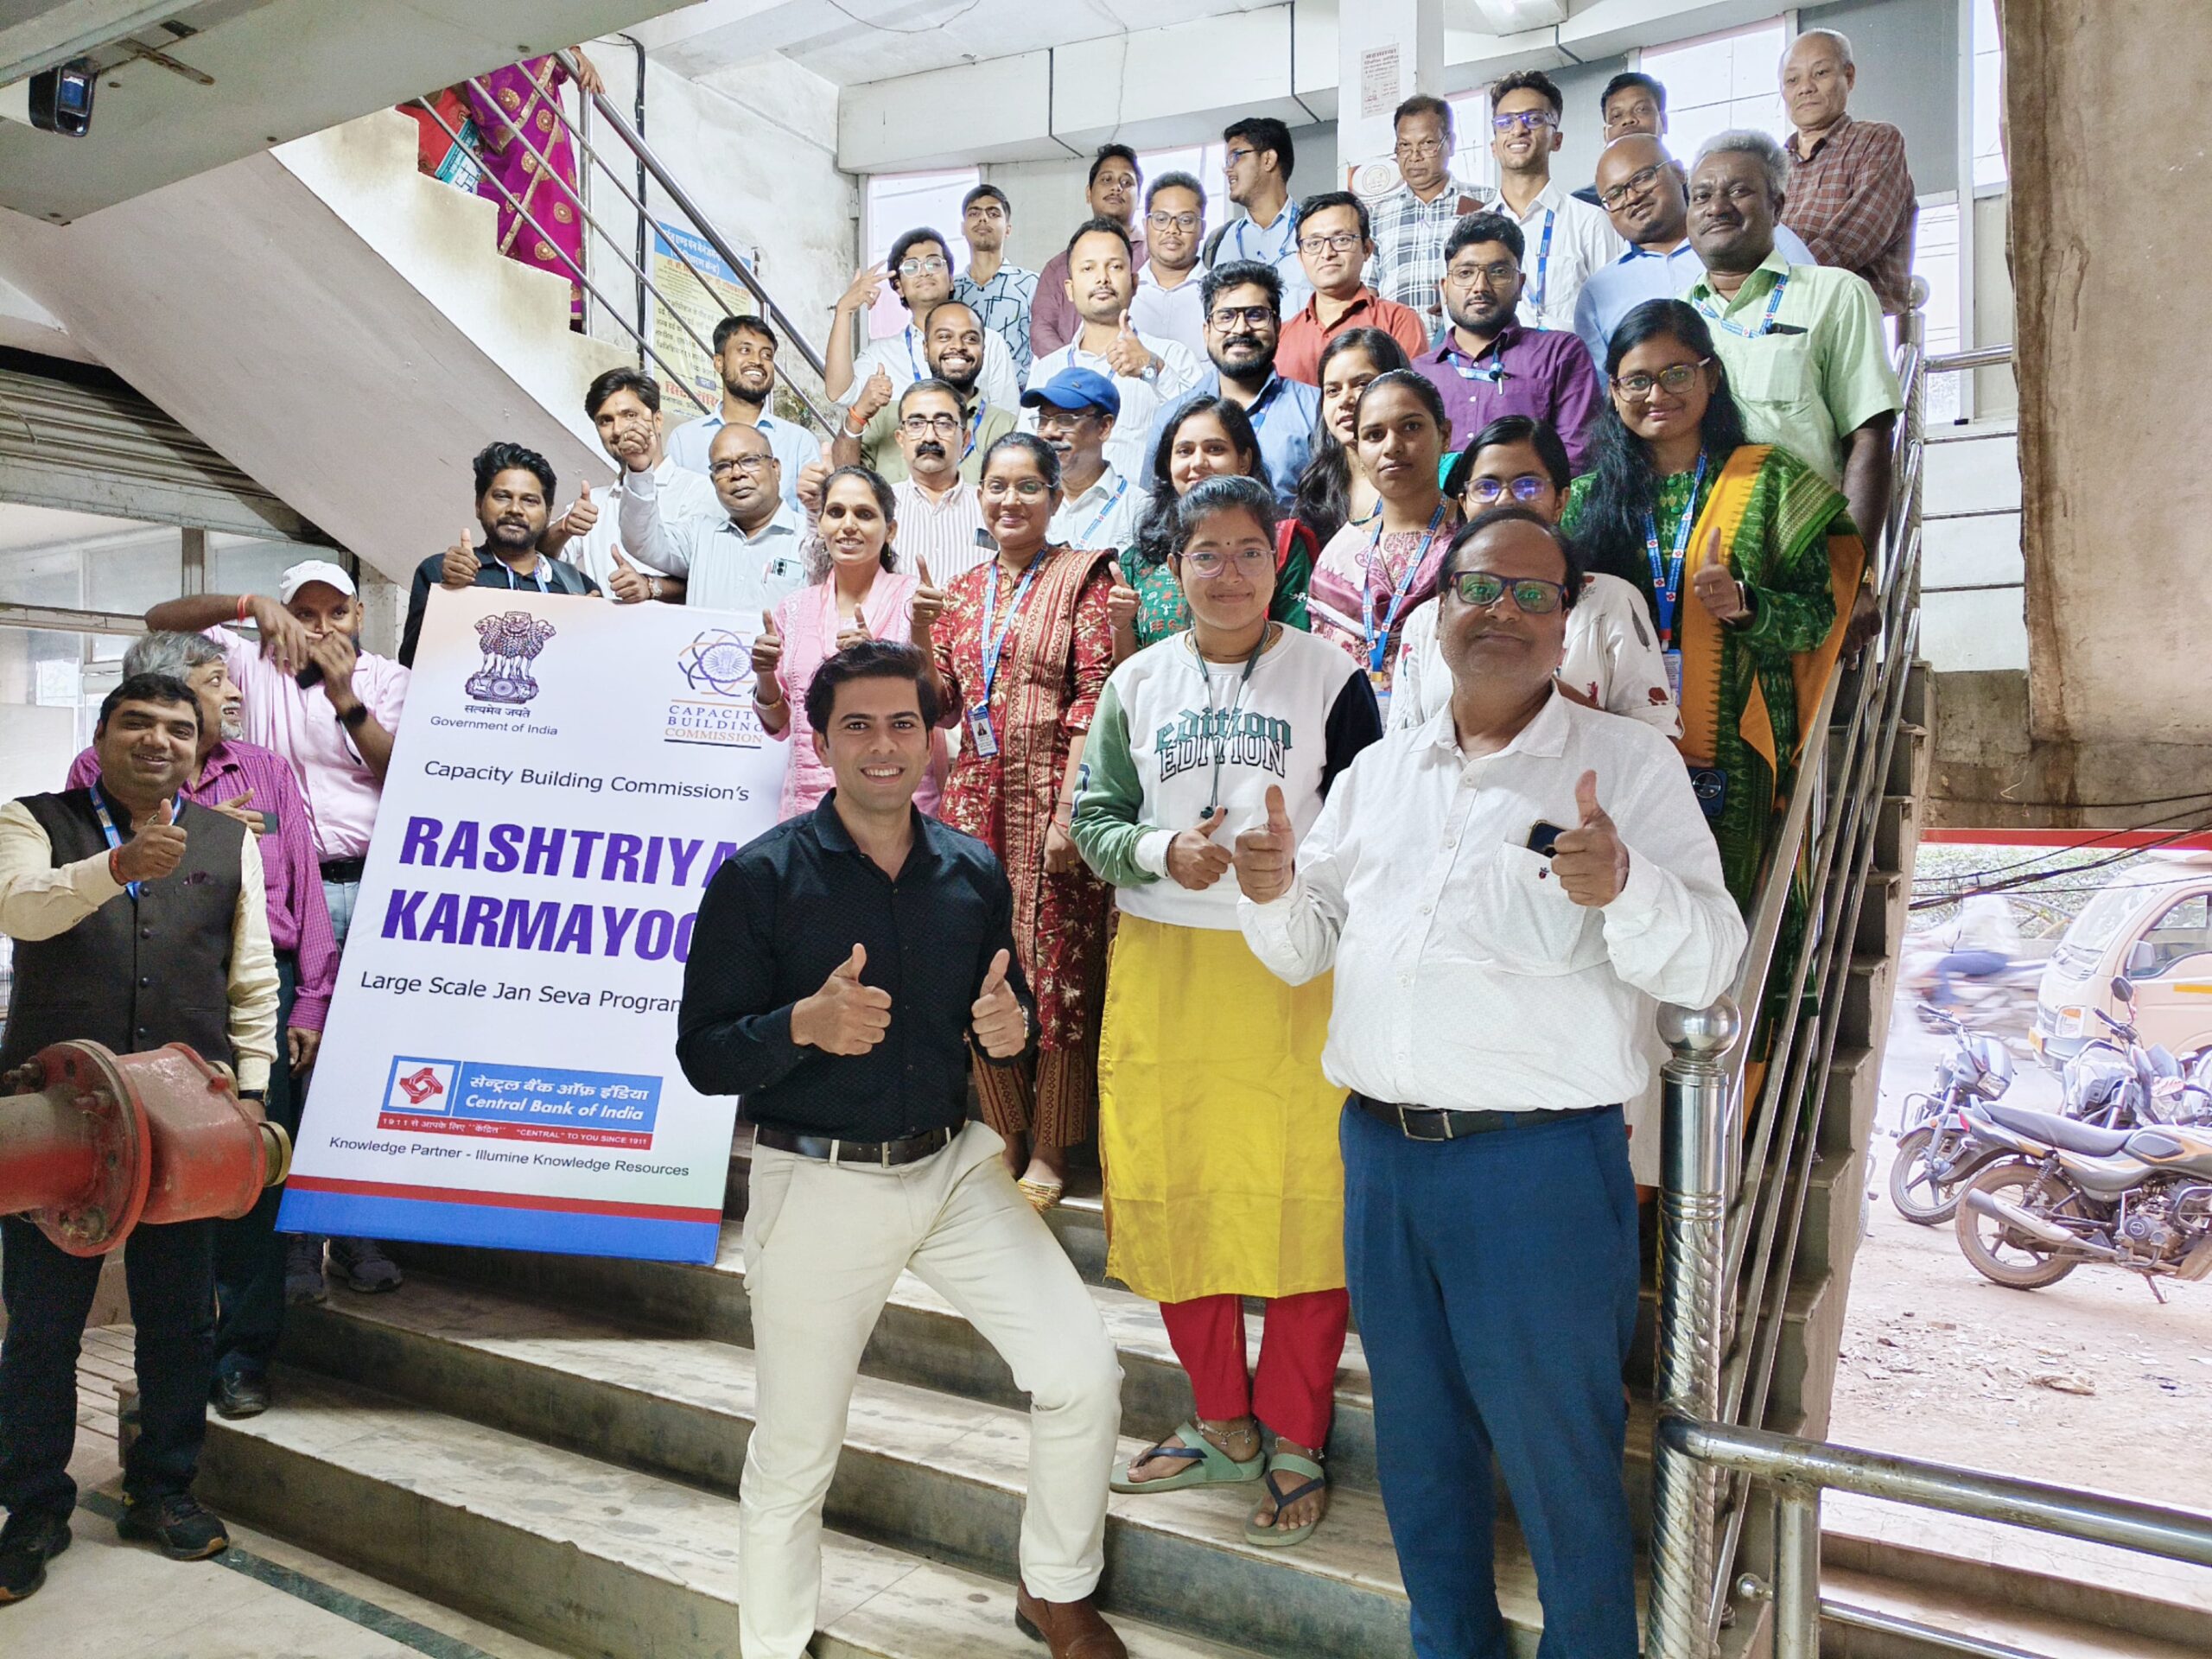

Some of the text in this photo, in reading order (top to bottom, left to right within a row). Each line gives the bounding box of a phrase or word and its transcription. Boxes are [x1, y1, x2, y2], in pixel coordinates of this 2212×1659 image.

[465, 704, 531, 718] सत्यमेव जयते
[668, 716, 763, 732] BUILDING
[669, 705, 753, 720] CAPACIT
[430, 716, 558, 735] Government of India
[664, 728, 762, 743] COMMISSION
[1154, 707, 1293, 754] edition
[1160, 733, 1286, 783] EDITION
[425, 760, 749, 802] Capacity Building Commission's
[398, 816, 738, 889] RASHTRIYA
[360, 971, 422, 995] Large
[429, 977, 486, 997] Scale
[493, 982, 531, 1001] Jan
[538, 986, 591, 1006] Seva
[470, 1075, 520, 1093] सेन्ट्रल
[523, 1078, 555, 1092] बैंक
[600, 1084, 649, 1101] इंडिया
[466, 1095, 644, 1121] Central Bank of India
[601, 1135, 627, 1144] SINCE
[329, 1136, 407, 1155] Knowledge
[410, 1144, 463, 1160] Partner
[475, 1149, 529, 1165] Illumine
[533, 1154, 611, 1172] Knowledge
[614, 1160, 690, 1177] Resources
